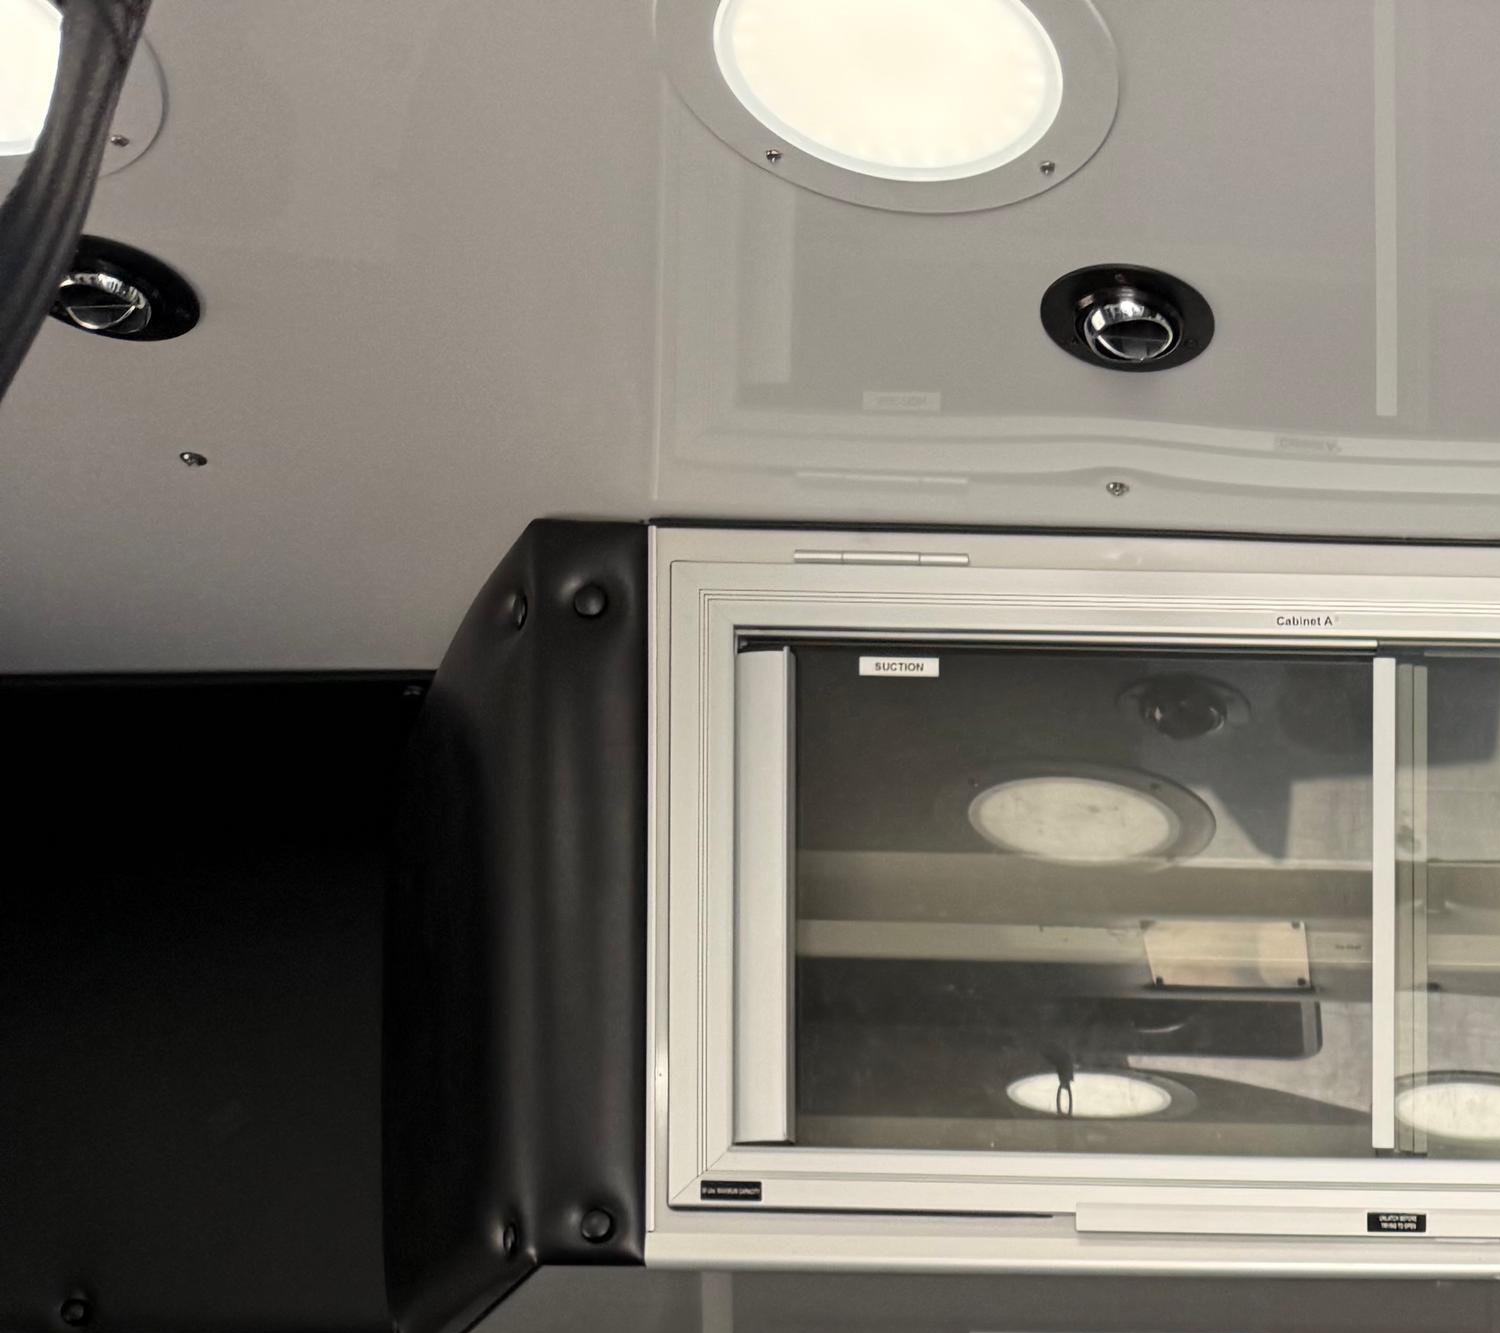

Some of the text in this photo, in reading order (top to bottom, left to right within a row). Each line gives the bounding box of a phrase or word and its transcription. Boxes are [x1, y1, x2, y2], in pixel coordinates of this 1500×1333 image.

[1276, 615, 1333, 626] Cabinet A
[875, 662, 924, 672] SUCTION
